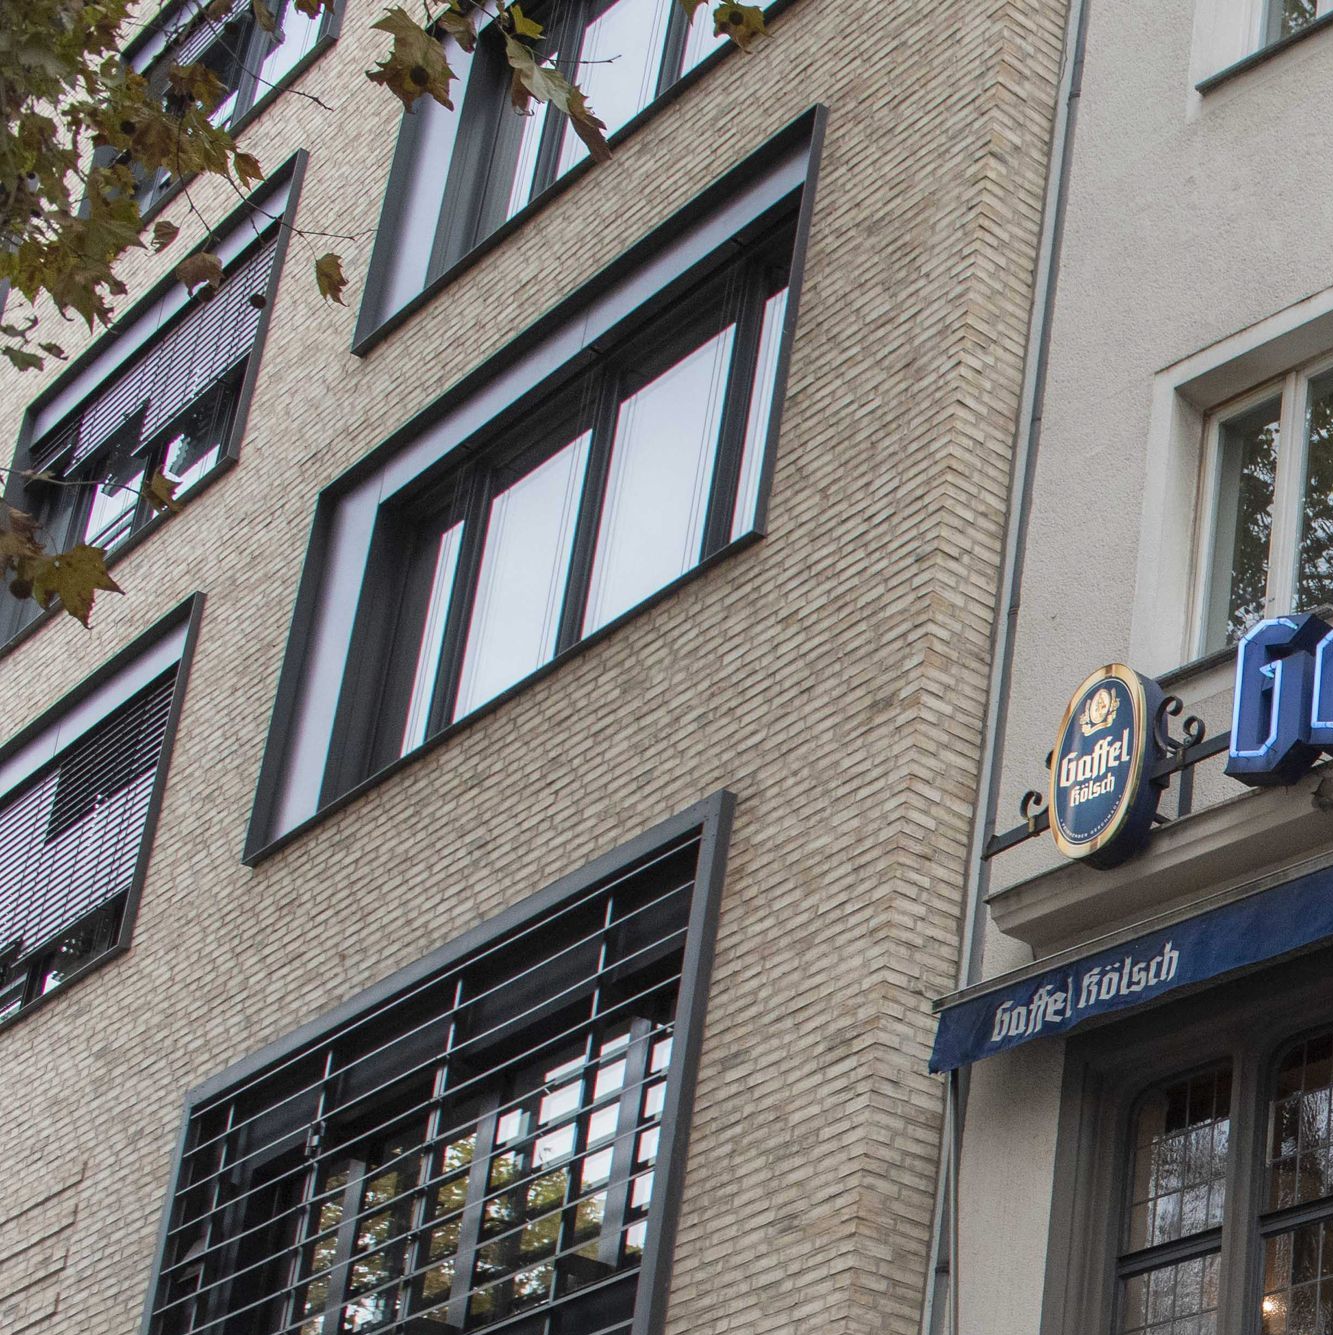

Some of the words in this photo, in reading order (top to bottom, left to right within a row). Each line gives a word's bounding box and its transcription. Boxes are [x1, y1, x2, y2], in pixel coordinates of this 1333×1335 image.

[1060, 728, 1130, 788] Gaffel
[1070, 772, 1115, 807] Kölsch
[993, 968, 1072, 1043] Gaffel
[1078, 941, 1180, 1009] Kölsch
